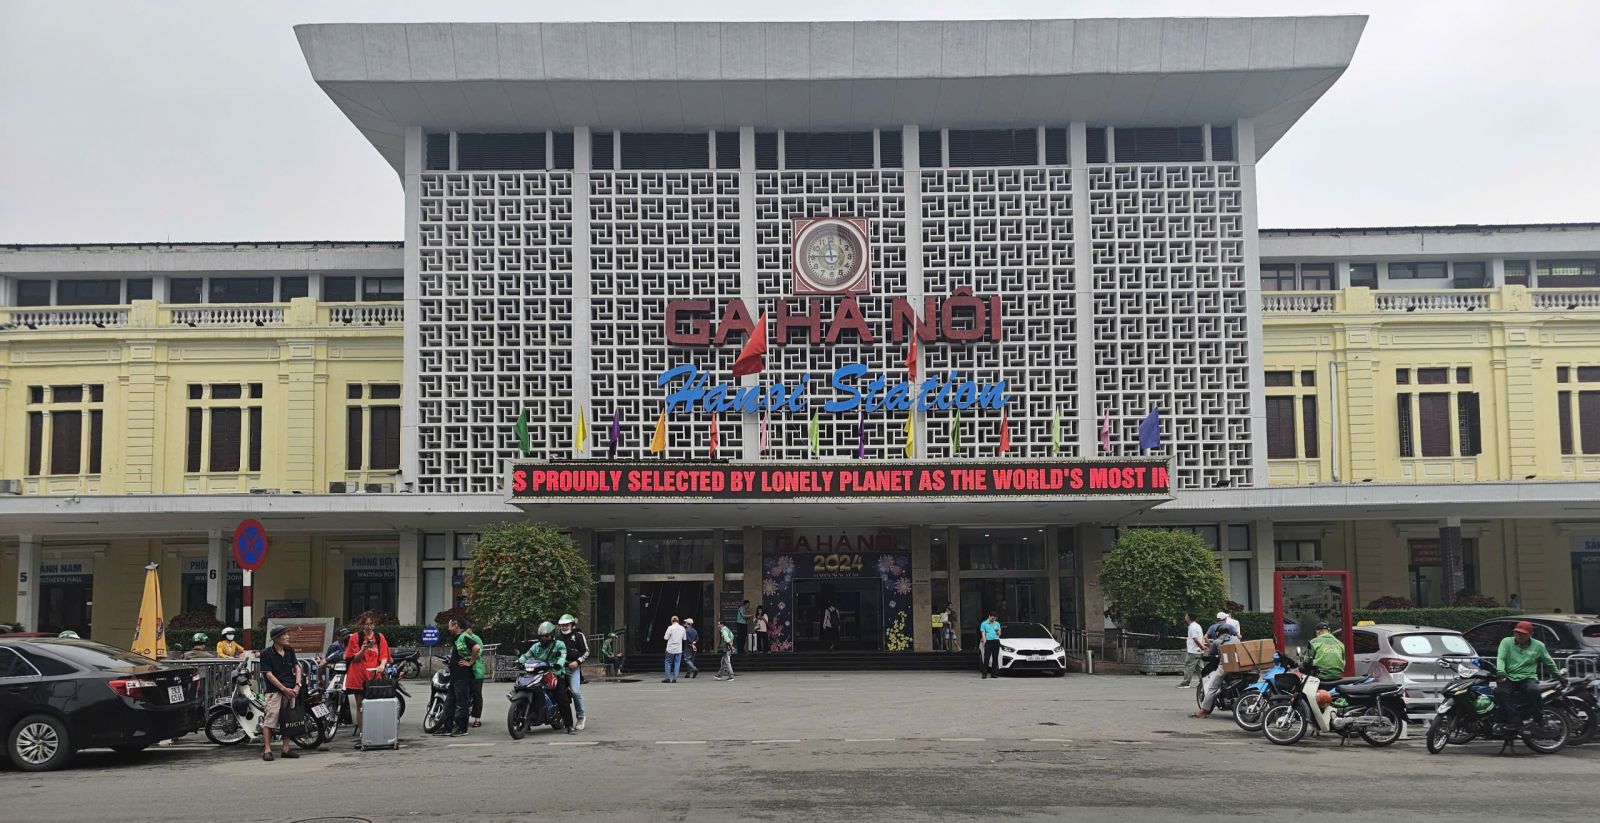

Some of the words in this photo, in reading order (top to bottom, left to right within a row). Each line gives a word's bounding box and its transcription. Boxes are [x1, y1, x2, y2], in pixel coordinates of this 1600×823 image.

[665, 298, 755, 346] GA
[776, 289, 874, 346] HÀ
[892, 286, 1002, 345] NỘI
[658, 363, 811, 414] Hanoi
[824, 363, 1011, 413] Station
[513, 470, 527, 492] S
[532, 470, 623, 492] PROUDLY
[628, 470, 725, 492] SELECTED
[730, 470, 755, 492] BY
[761, 470, 834, 492] LONELY
[839, 470, 913, 492] PLANET
[918, 470, 946, 491] AS
[951, 469, 987, 490] THE
[993, 468, 1084, 490] WORLD'S
[1089, 467, 1147, 489] MOST
[210, 569, 217, 580] 6
[813, 554, 864, 573] 2024
[20, 572, 27, 582] 5
